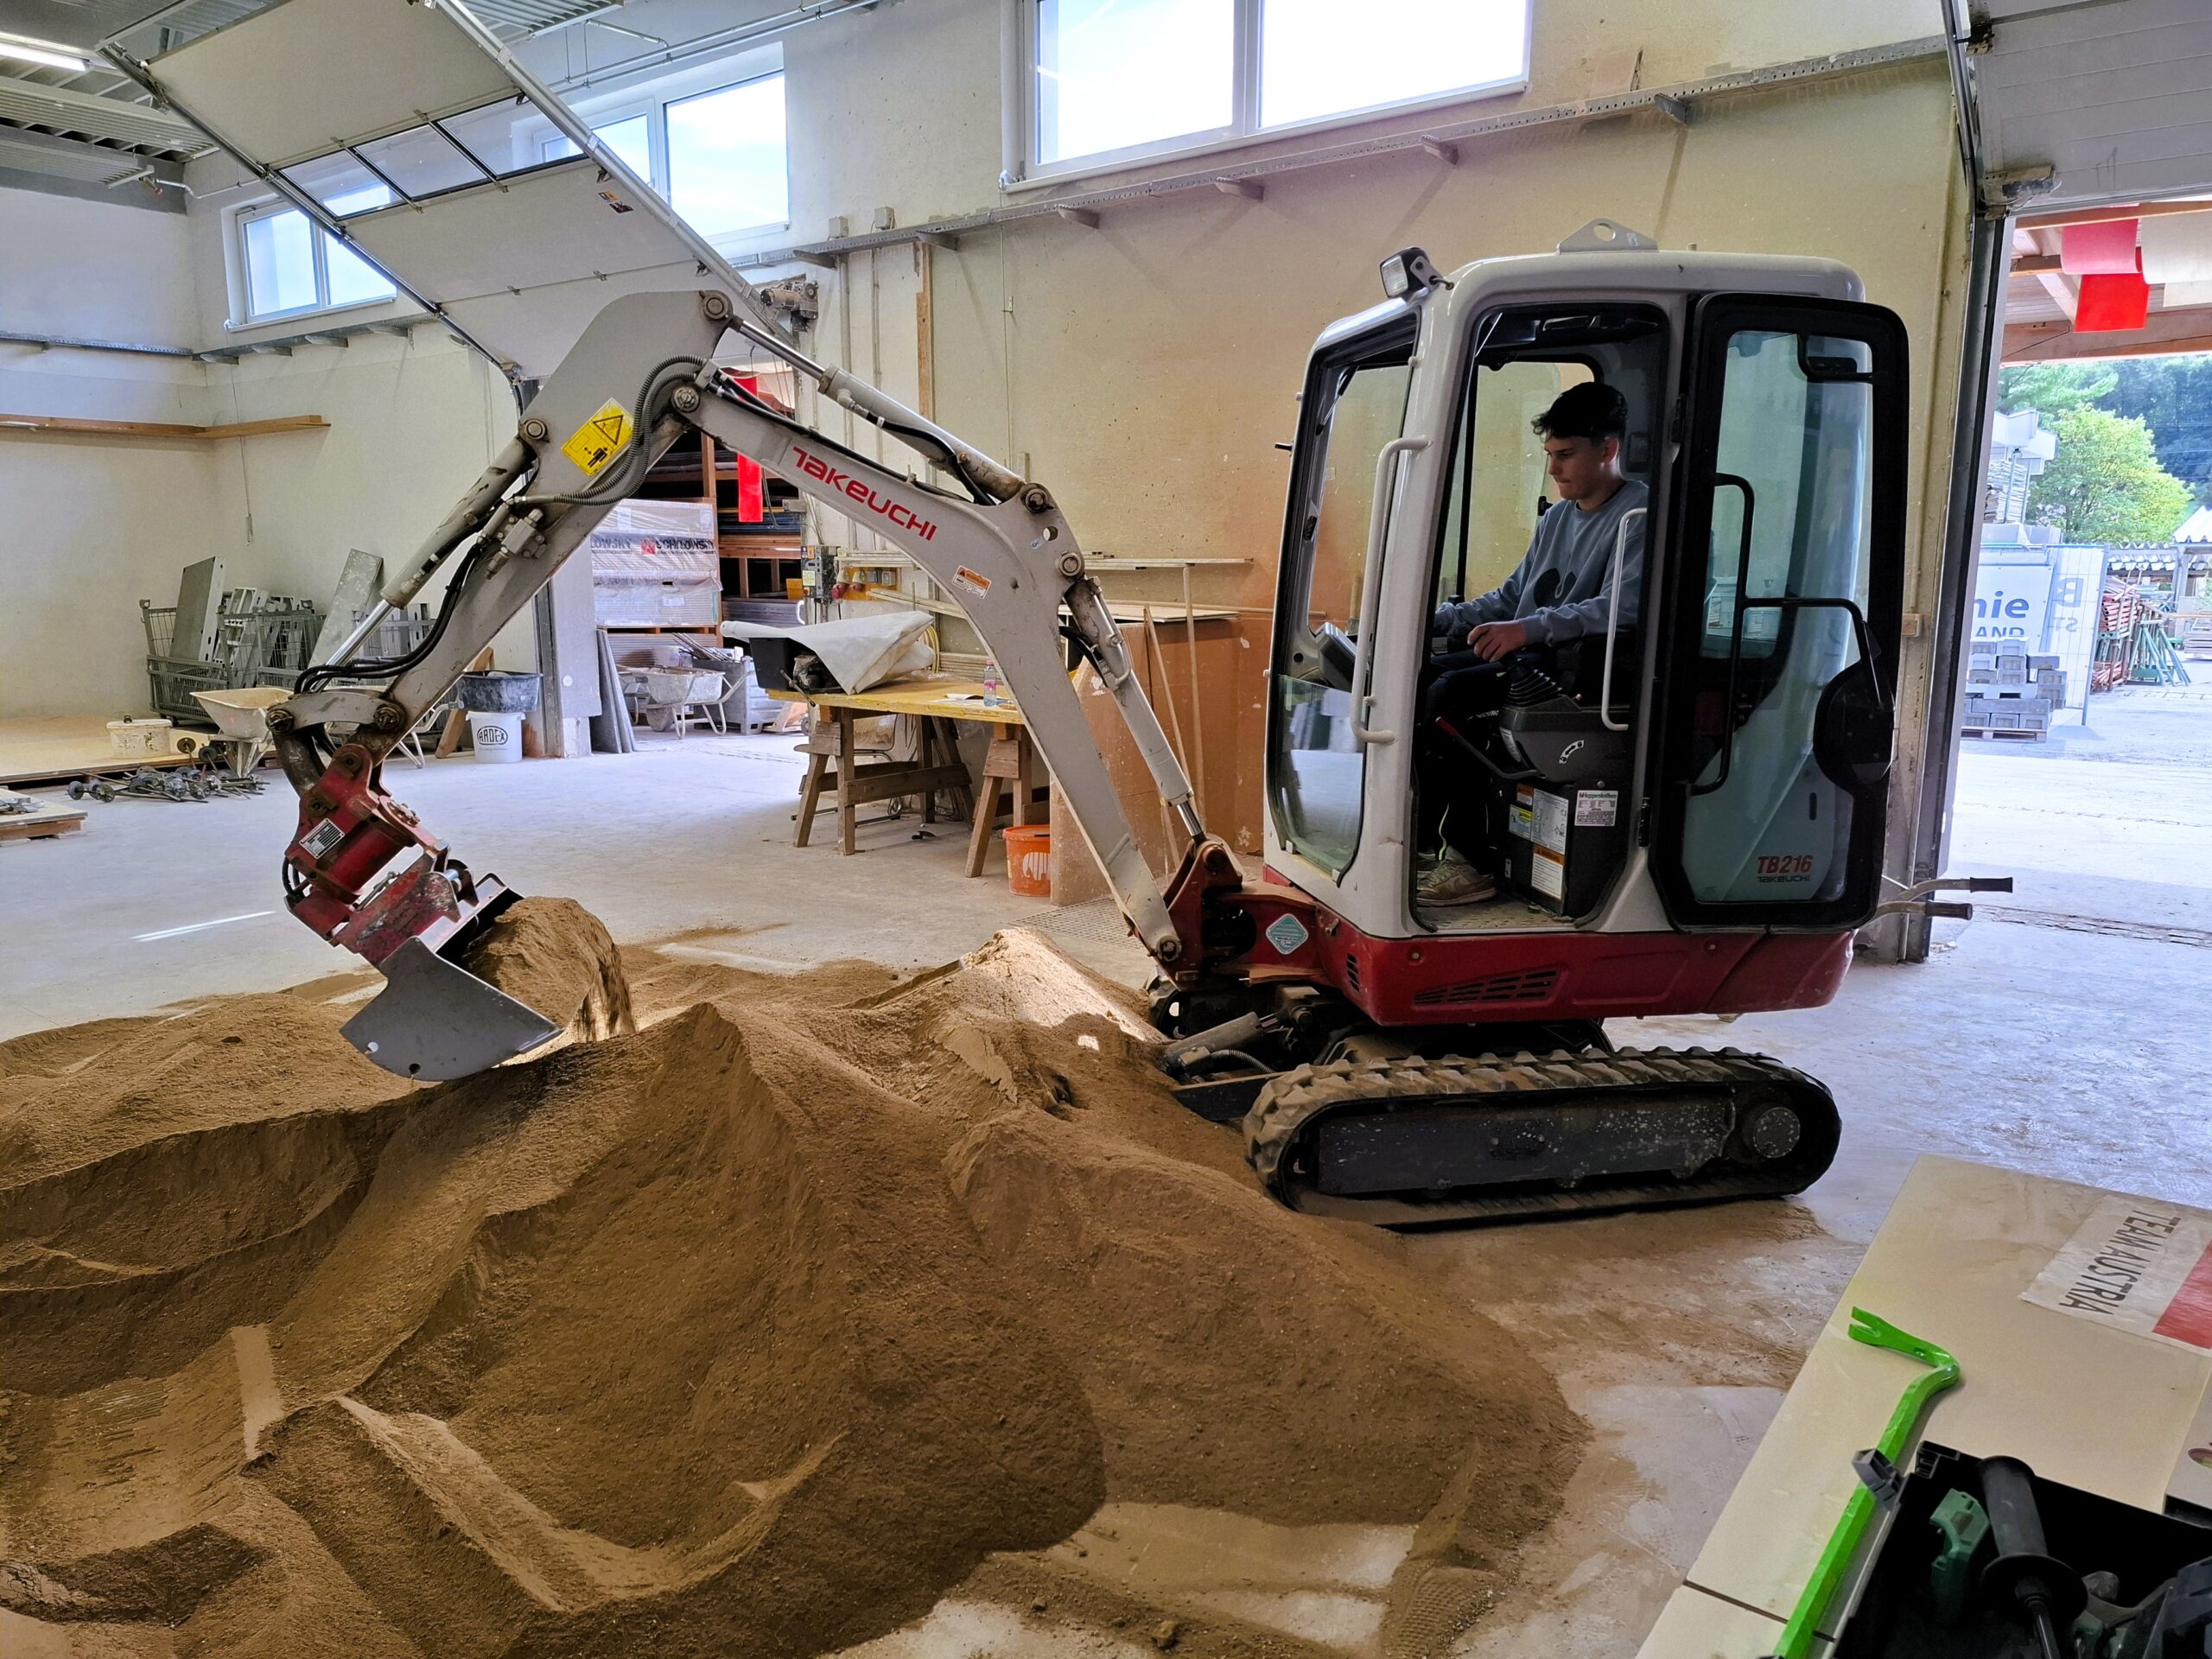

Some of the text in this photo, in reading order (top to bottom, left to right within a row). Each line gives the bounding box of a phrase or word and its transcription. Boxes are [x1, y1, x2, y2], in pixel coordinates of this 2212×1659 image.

[480, 728, 505, 742] ARDEX
[1758, 855, 1814, 874] TB216
[2058, 1210, 2182, 1315] TEAM AUSTRIA
